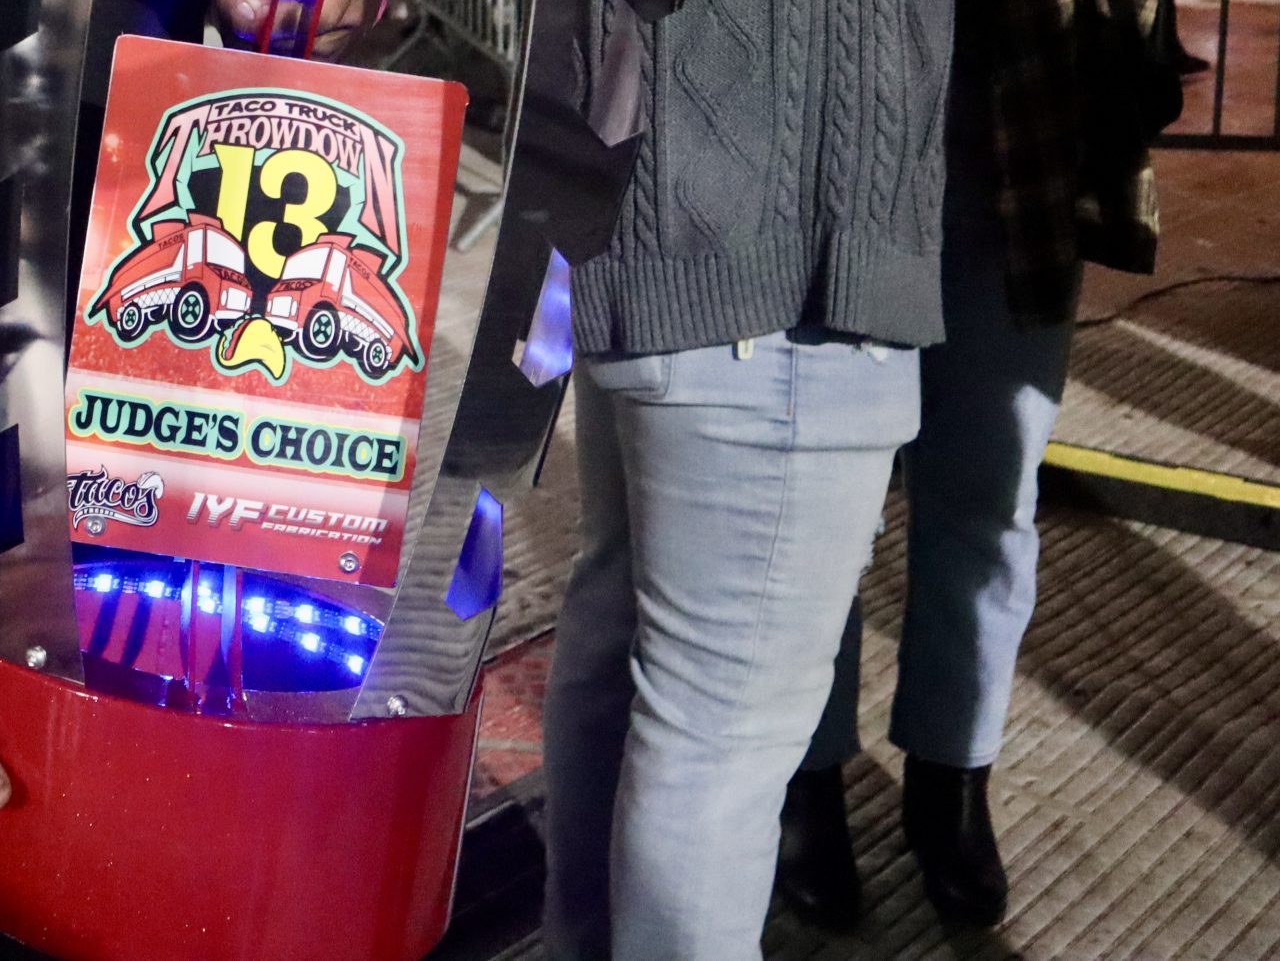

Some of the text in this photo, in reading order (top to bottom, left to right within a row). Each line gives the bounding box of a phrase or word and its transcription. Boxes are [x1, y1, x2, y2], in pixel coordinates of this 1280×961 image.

[215, 99, 357, 138] TACO TRUCK
[139, 103, 400, 255] THROWDOWN
[214, 143, 338, 280] 13
[157, 232, 185, 252] TACOS
[349, 256, 371, 280] TACOS
[75, 393, 401, 476] JUDGE'S CHOICE
[186, 492, 389, 533] IYF CUSTOM
[260, 522, 383, 545] FABRICATION
